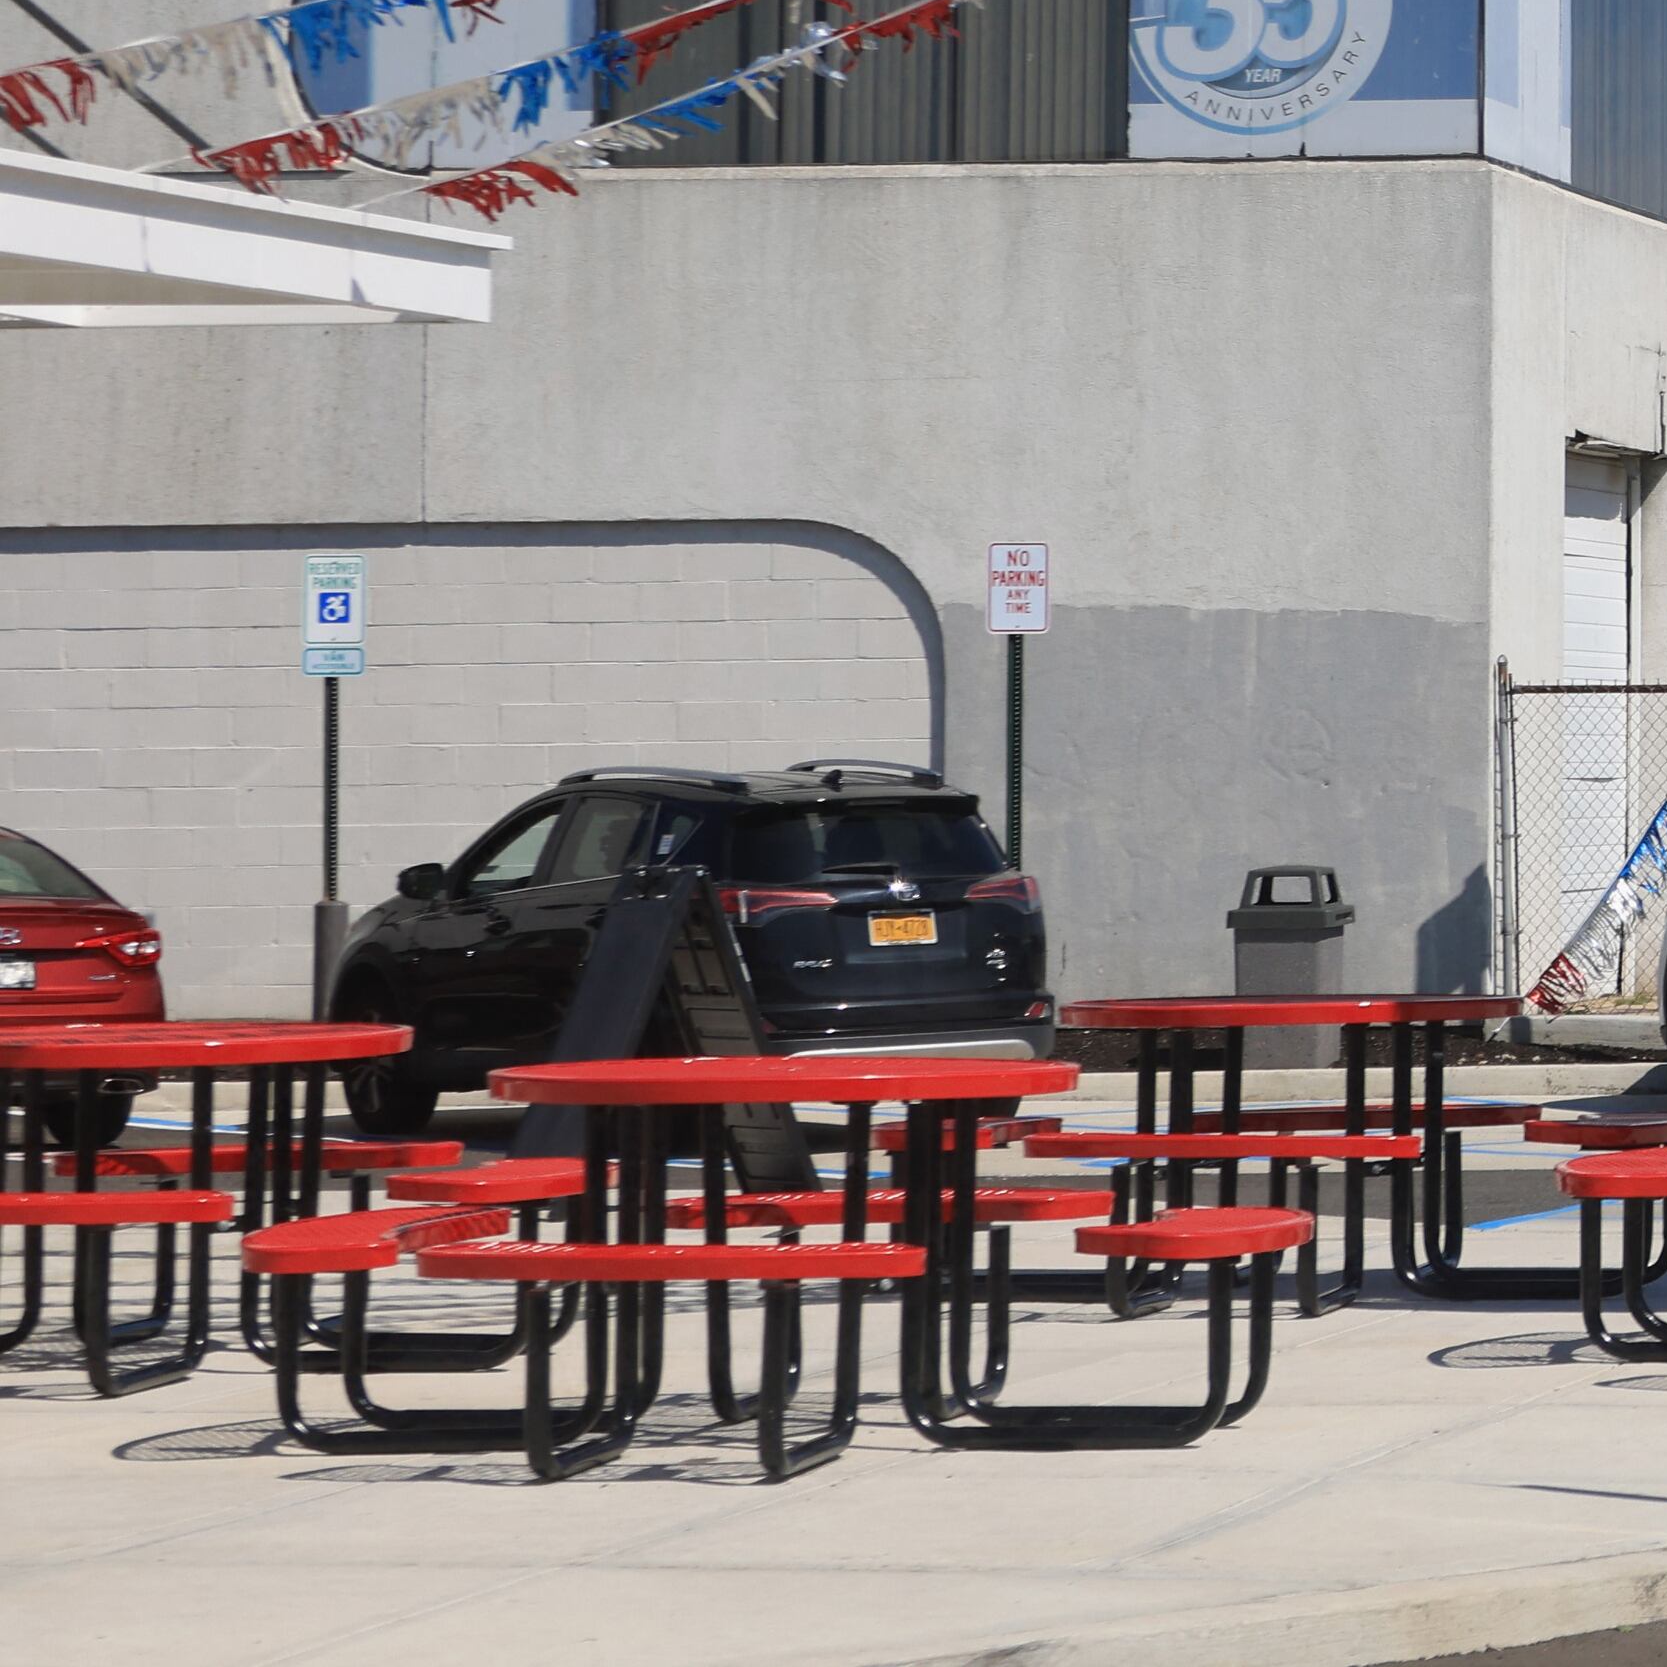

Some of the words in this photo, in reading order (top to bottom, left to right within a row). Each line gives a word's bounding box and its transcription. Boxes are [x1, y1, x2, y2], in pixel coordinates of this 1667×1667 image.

[1184, 30, 1368, 125] ANNIVERSARY
[1244, 68, 1282, 84] YEAR
[1007, 550, 1030, 567] NO
[991, 570, 1045, 587] PARKING
[1007, 589, 1031, 600] ANY
[1005, 602, 1032, 614] TIME
